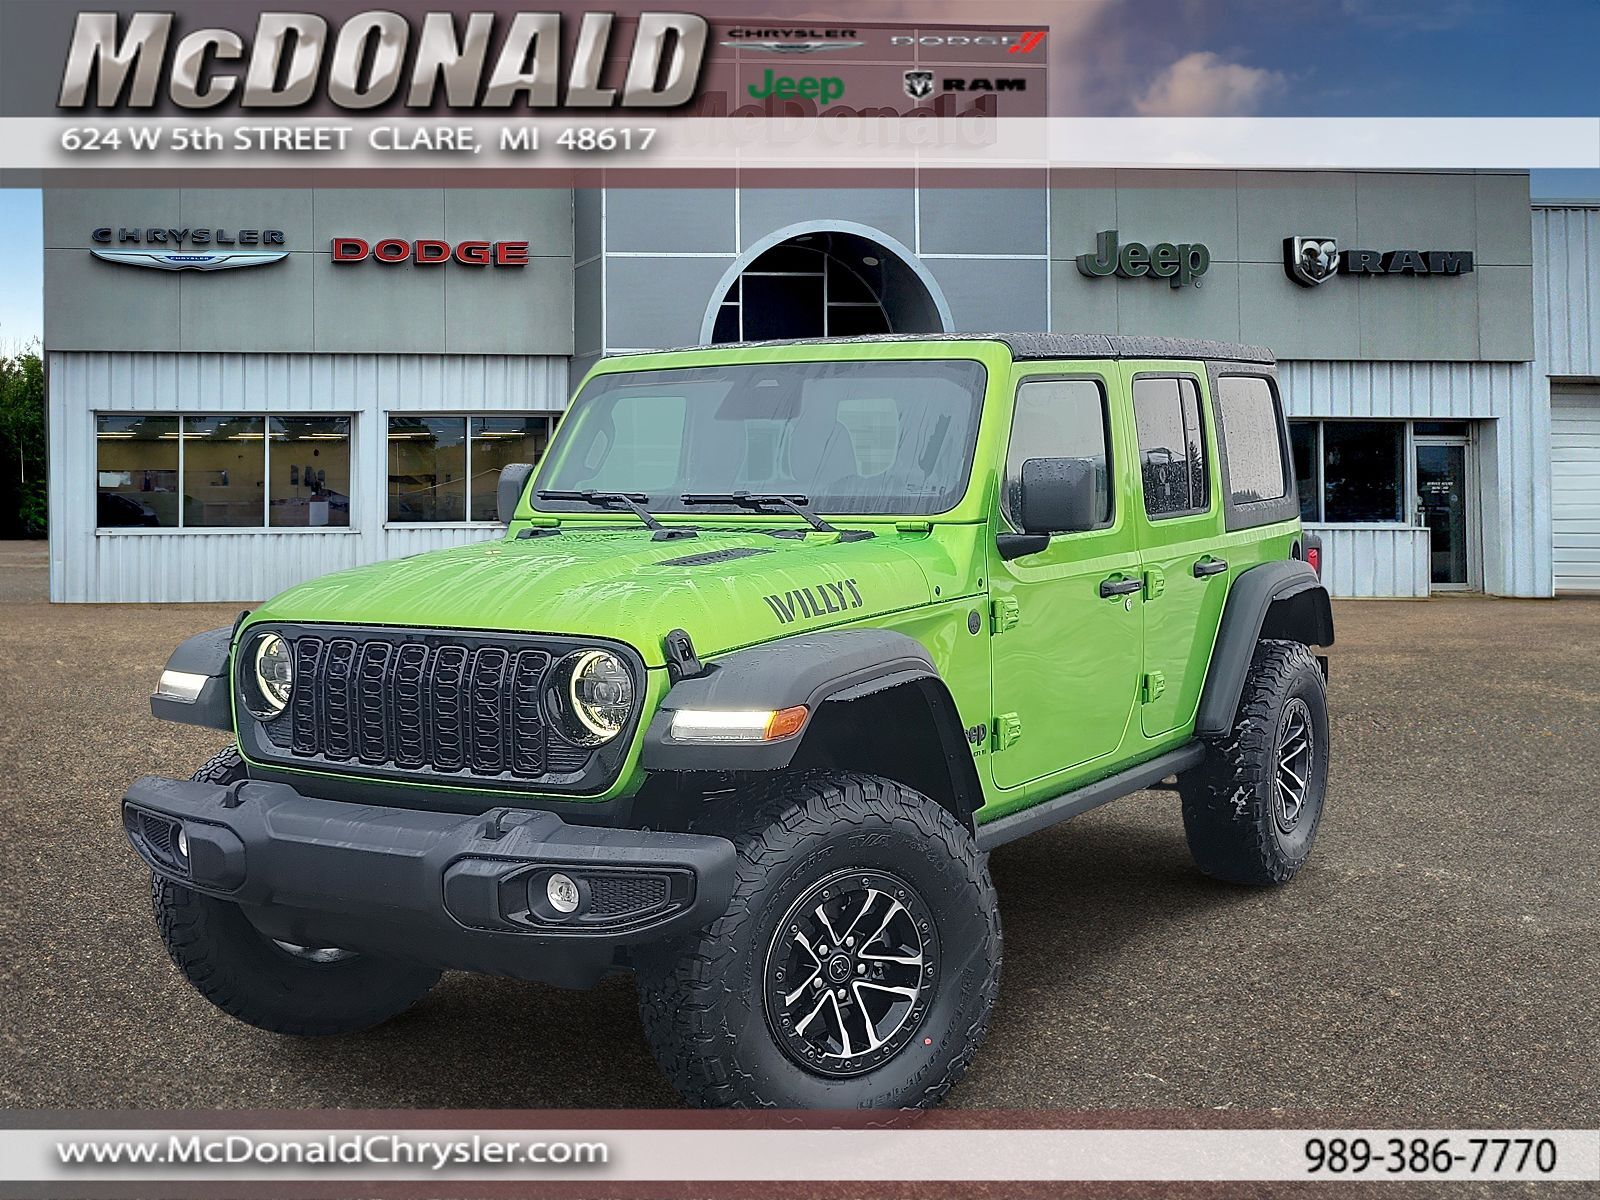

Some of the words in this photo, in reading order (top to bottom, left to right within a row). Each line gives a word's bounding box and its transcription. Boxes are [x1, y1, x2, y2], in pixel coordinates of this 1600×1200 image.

[92, 228, 286, 243] CHRYSLER
[331, 238, 529, 267] DODGE
[1078, 230, 1211, 288] Jeep
[1345, 250, 1474, 274] RAM
[763, 579, 862, 623] WILLYS
[966, 723, 987, 747] ep
